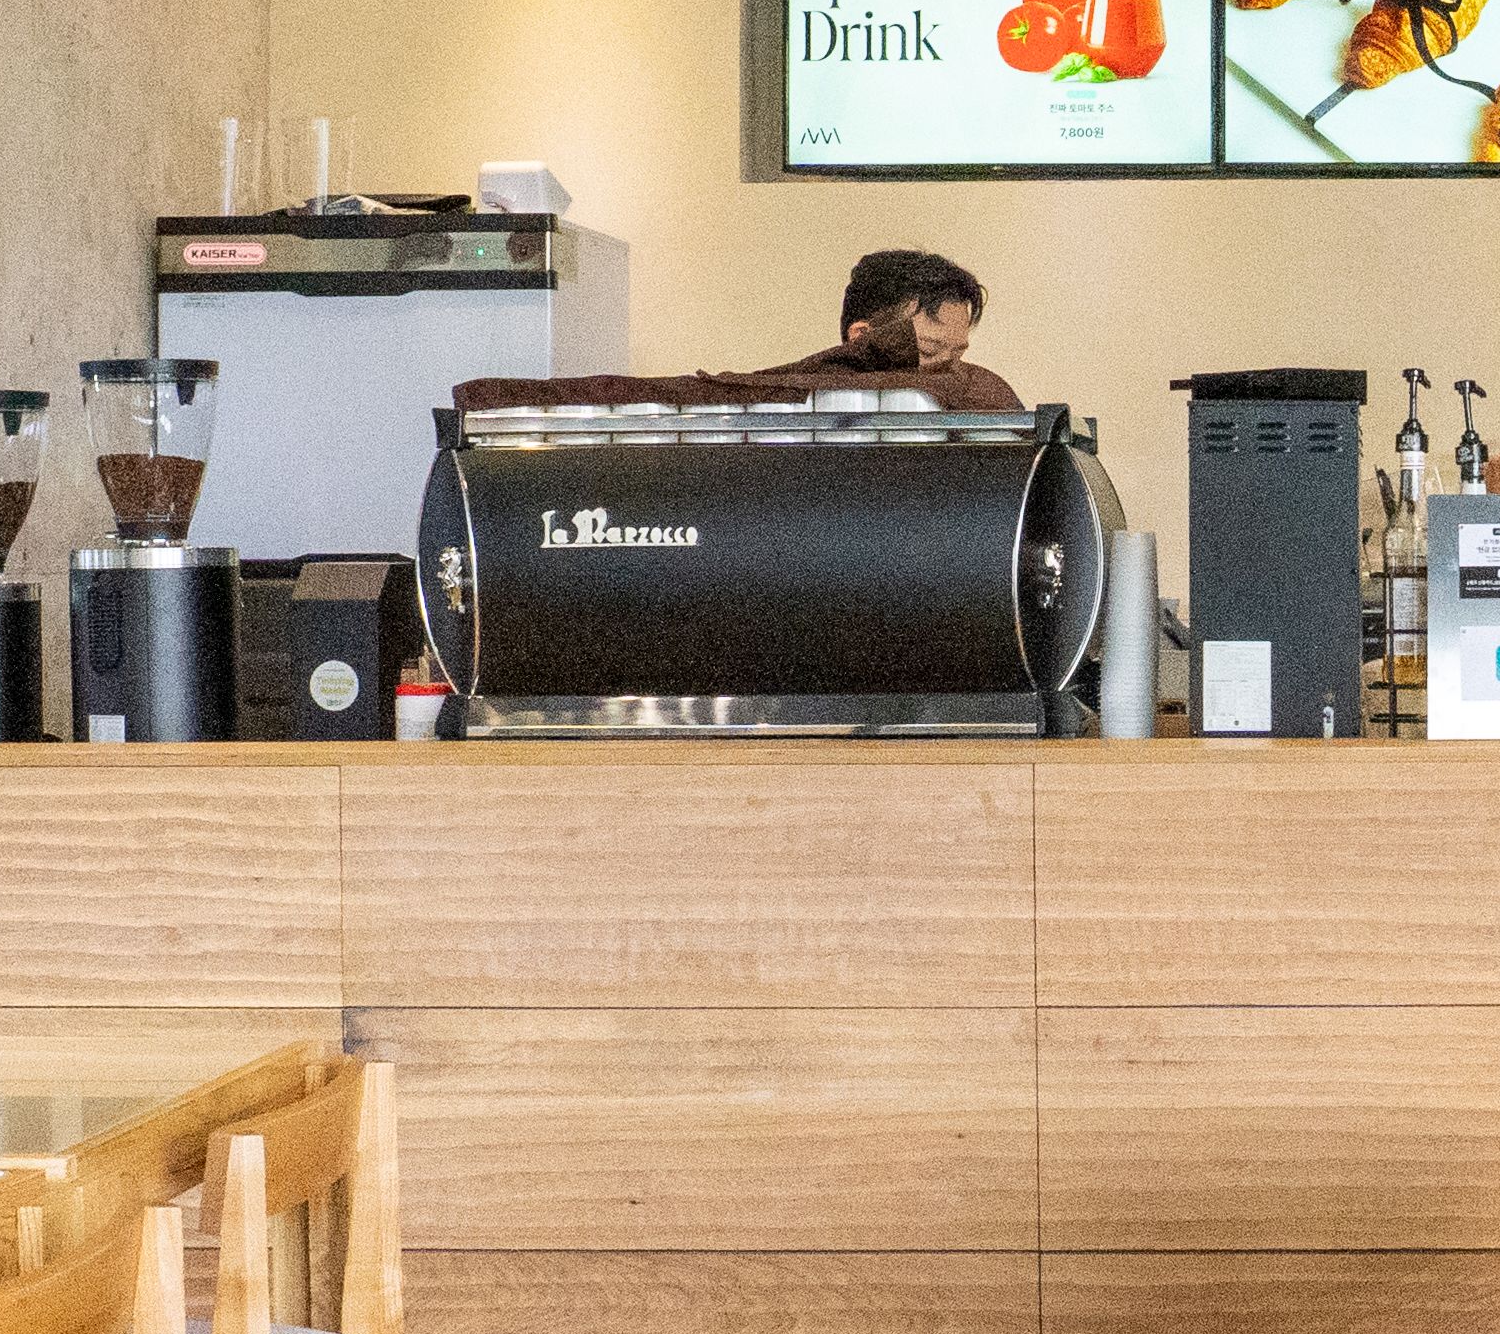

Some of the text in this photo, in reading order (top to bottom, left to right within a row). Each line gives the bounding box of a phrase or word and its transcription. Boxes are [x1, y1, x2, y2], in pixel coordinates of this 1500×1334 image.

[801, 10, 943, 62] Drink
[1069, 103, 1095, 113] 토마토
[1098, 103, 1115, 113] 주스
[1059, 126, 1104, 140] 7,800원
[191, 249, 237, 259] KAISER
[540, 507, 698, 547] La Marzocco
